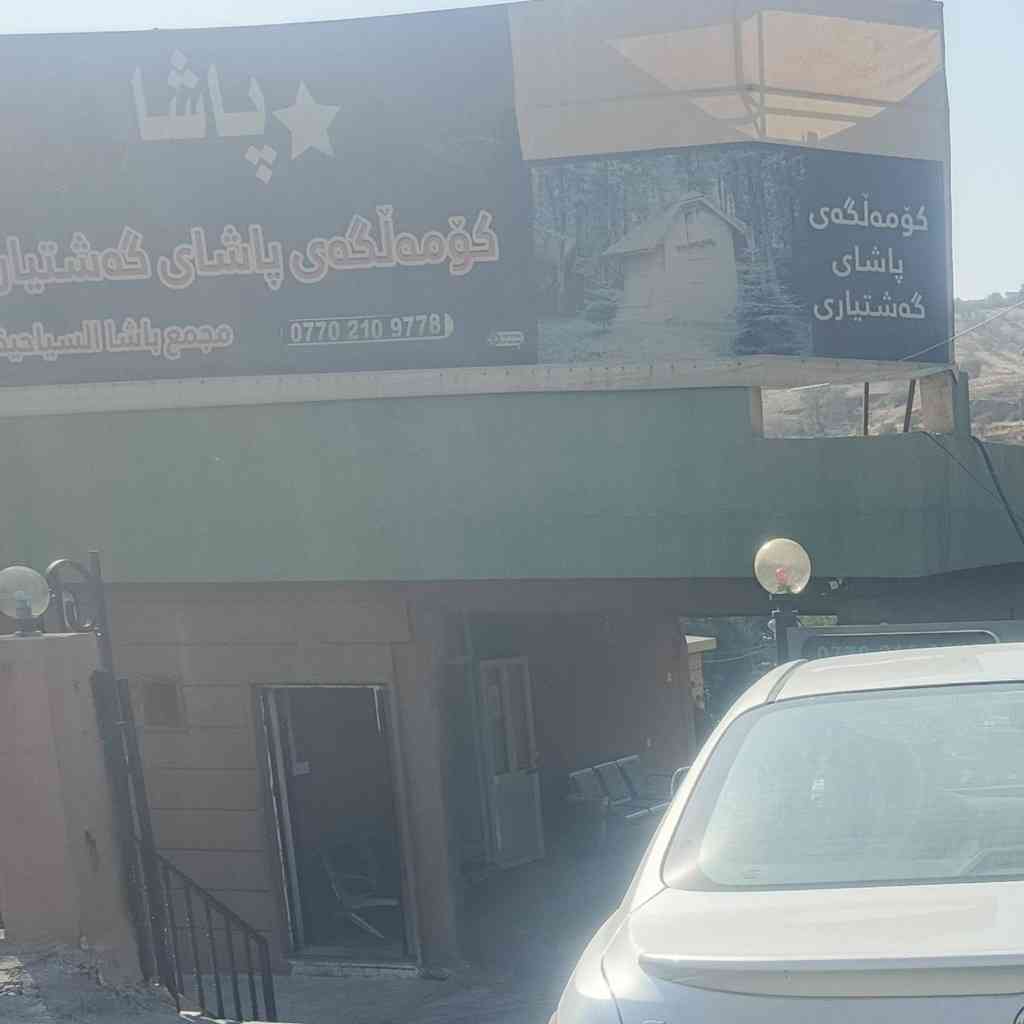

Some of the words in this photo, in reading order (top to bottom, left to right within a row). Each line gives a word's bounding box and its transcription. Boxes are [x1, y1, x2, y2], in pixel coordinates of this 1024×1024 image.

[130, 48, 277, 184] پاشا
[0, 226, 152, 296] گەشتیار
[157, 225, 284, 291] پاشای
[831, 245, 904, 285] پاشای
[290, 321, 340, 343] 0770
[348, 319, 384, 340] 210
[390, 313, 441, 337] 9778
